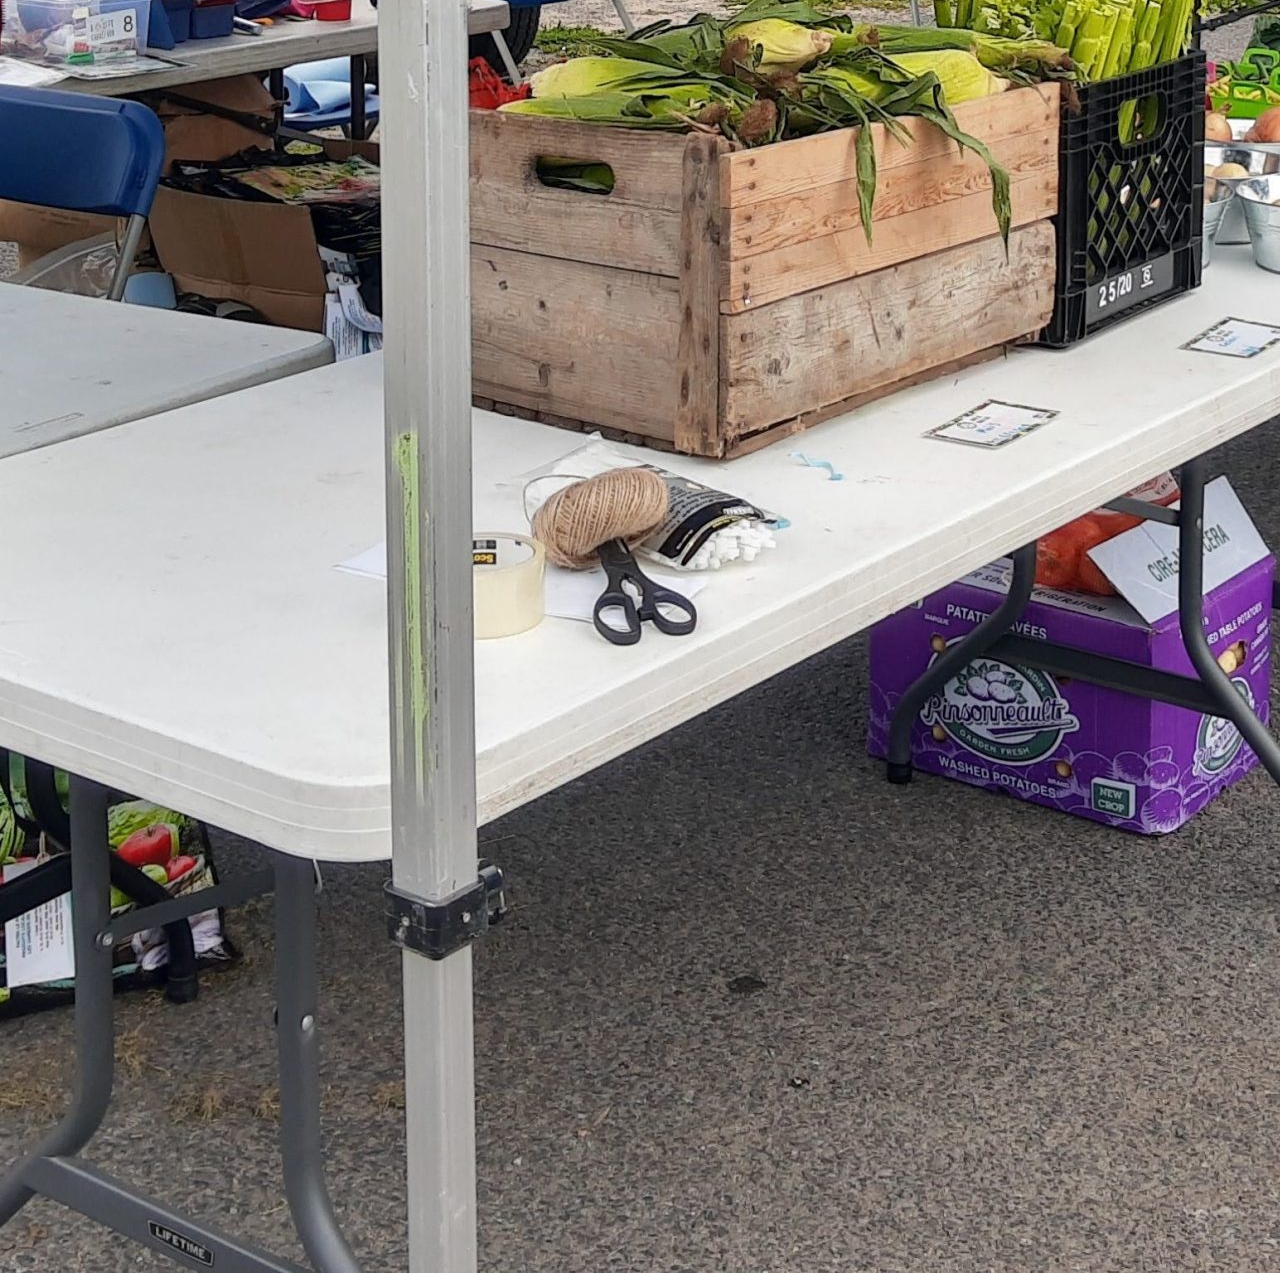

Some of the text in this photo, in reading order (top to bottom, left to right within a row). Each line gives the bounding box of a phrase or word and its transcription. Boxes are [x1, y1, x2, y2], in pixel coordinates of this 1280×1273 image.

[123, 15, 133, 32] 8
[473, 554, 494, 563] Sco
[1033, 589, 1107, 612] RIGÉRATION
[946, 604, 1047, 640] PATATE AVÉES
[1219, 620, 1238, 639] TABLE
[1020, 664, 1045, 692] ARDIN
[958, 730, 1030, 756] GARDEN FRESH
[938, 755, 1057, 799] WASHED POTATOES
[1099, 786, 1123, 800] NEW
[1097, 799, 1125, 813] CROP
[155, 1226, 206, 1259] LIFETIME
